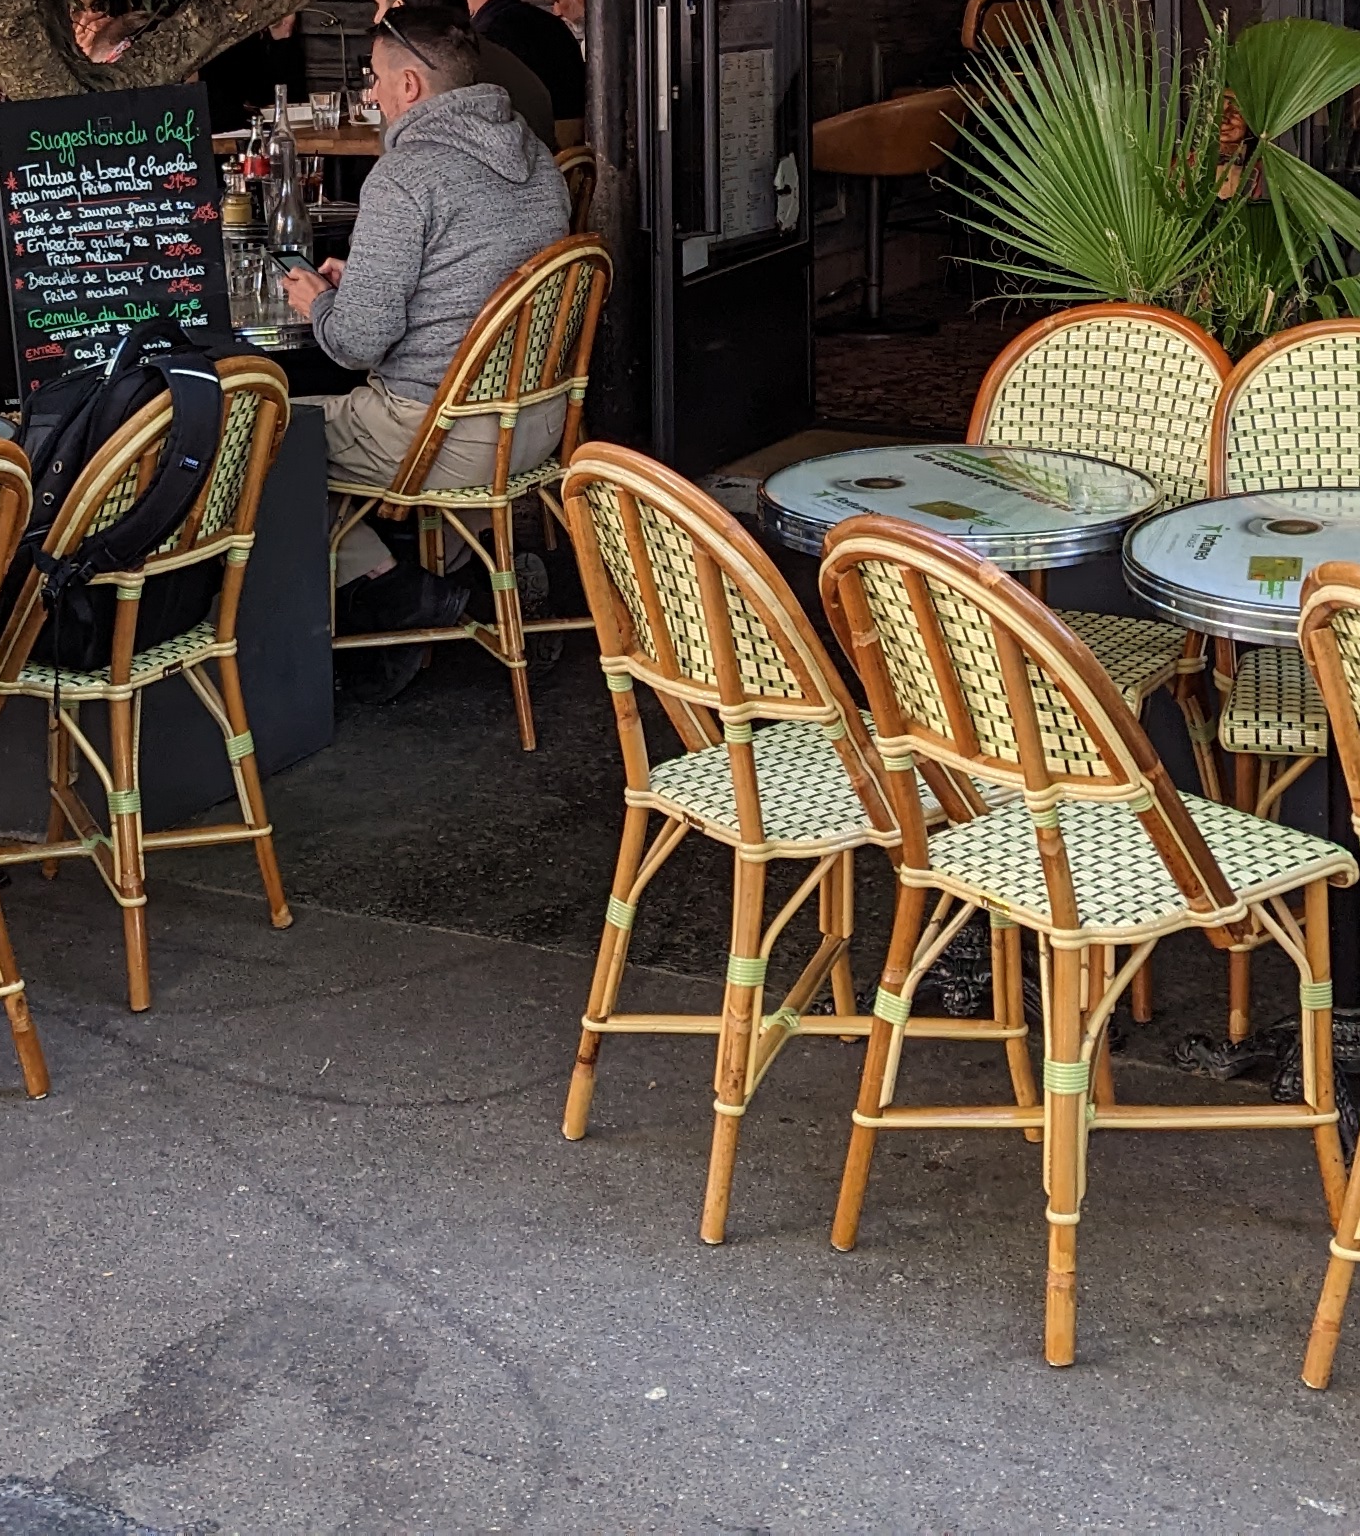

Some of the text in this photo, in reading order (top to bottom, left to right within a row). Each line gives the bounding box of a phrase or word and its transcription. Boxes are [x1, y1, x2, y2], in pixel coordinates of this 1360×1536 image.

[27, 119, 123, 166] Suggestions
[125, 120, 148, 145] du
[18, 161, 76, 188] Tartare
[79, 165, 96, 182] de
[115, 177, 153, 193] maison
[23, 207, 54, 224] Pavé
[56, 207, 73, 221] de
[159, 200, 175, 213] et
[175, 202, 196, 211] sa
[49, 222, 64, 236] de
[27, 233, 86, 254] Entrecôte
[85, 250, 123, 264] maison
[25, 268, 81, 290] Brochette
[82, 272, 102, 285] de
[86, 286, 129, 300] maison
[28, 306, 90, 329] Formule
[97, 305, 117, 321] du
[168, 298, 202, 319] 15€
[90, 323, 112, 337] plat
